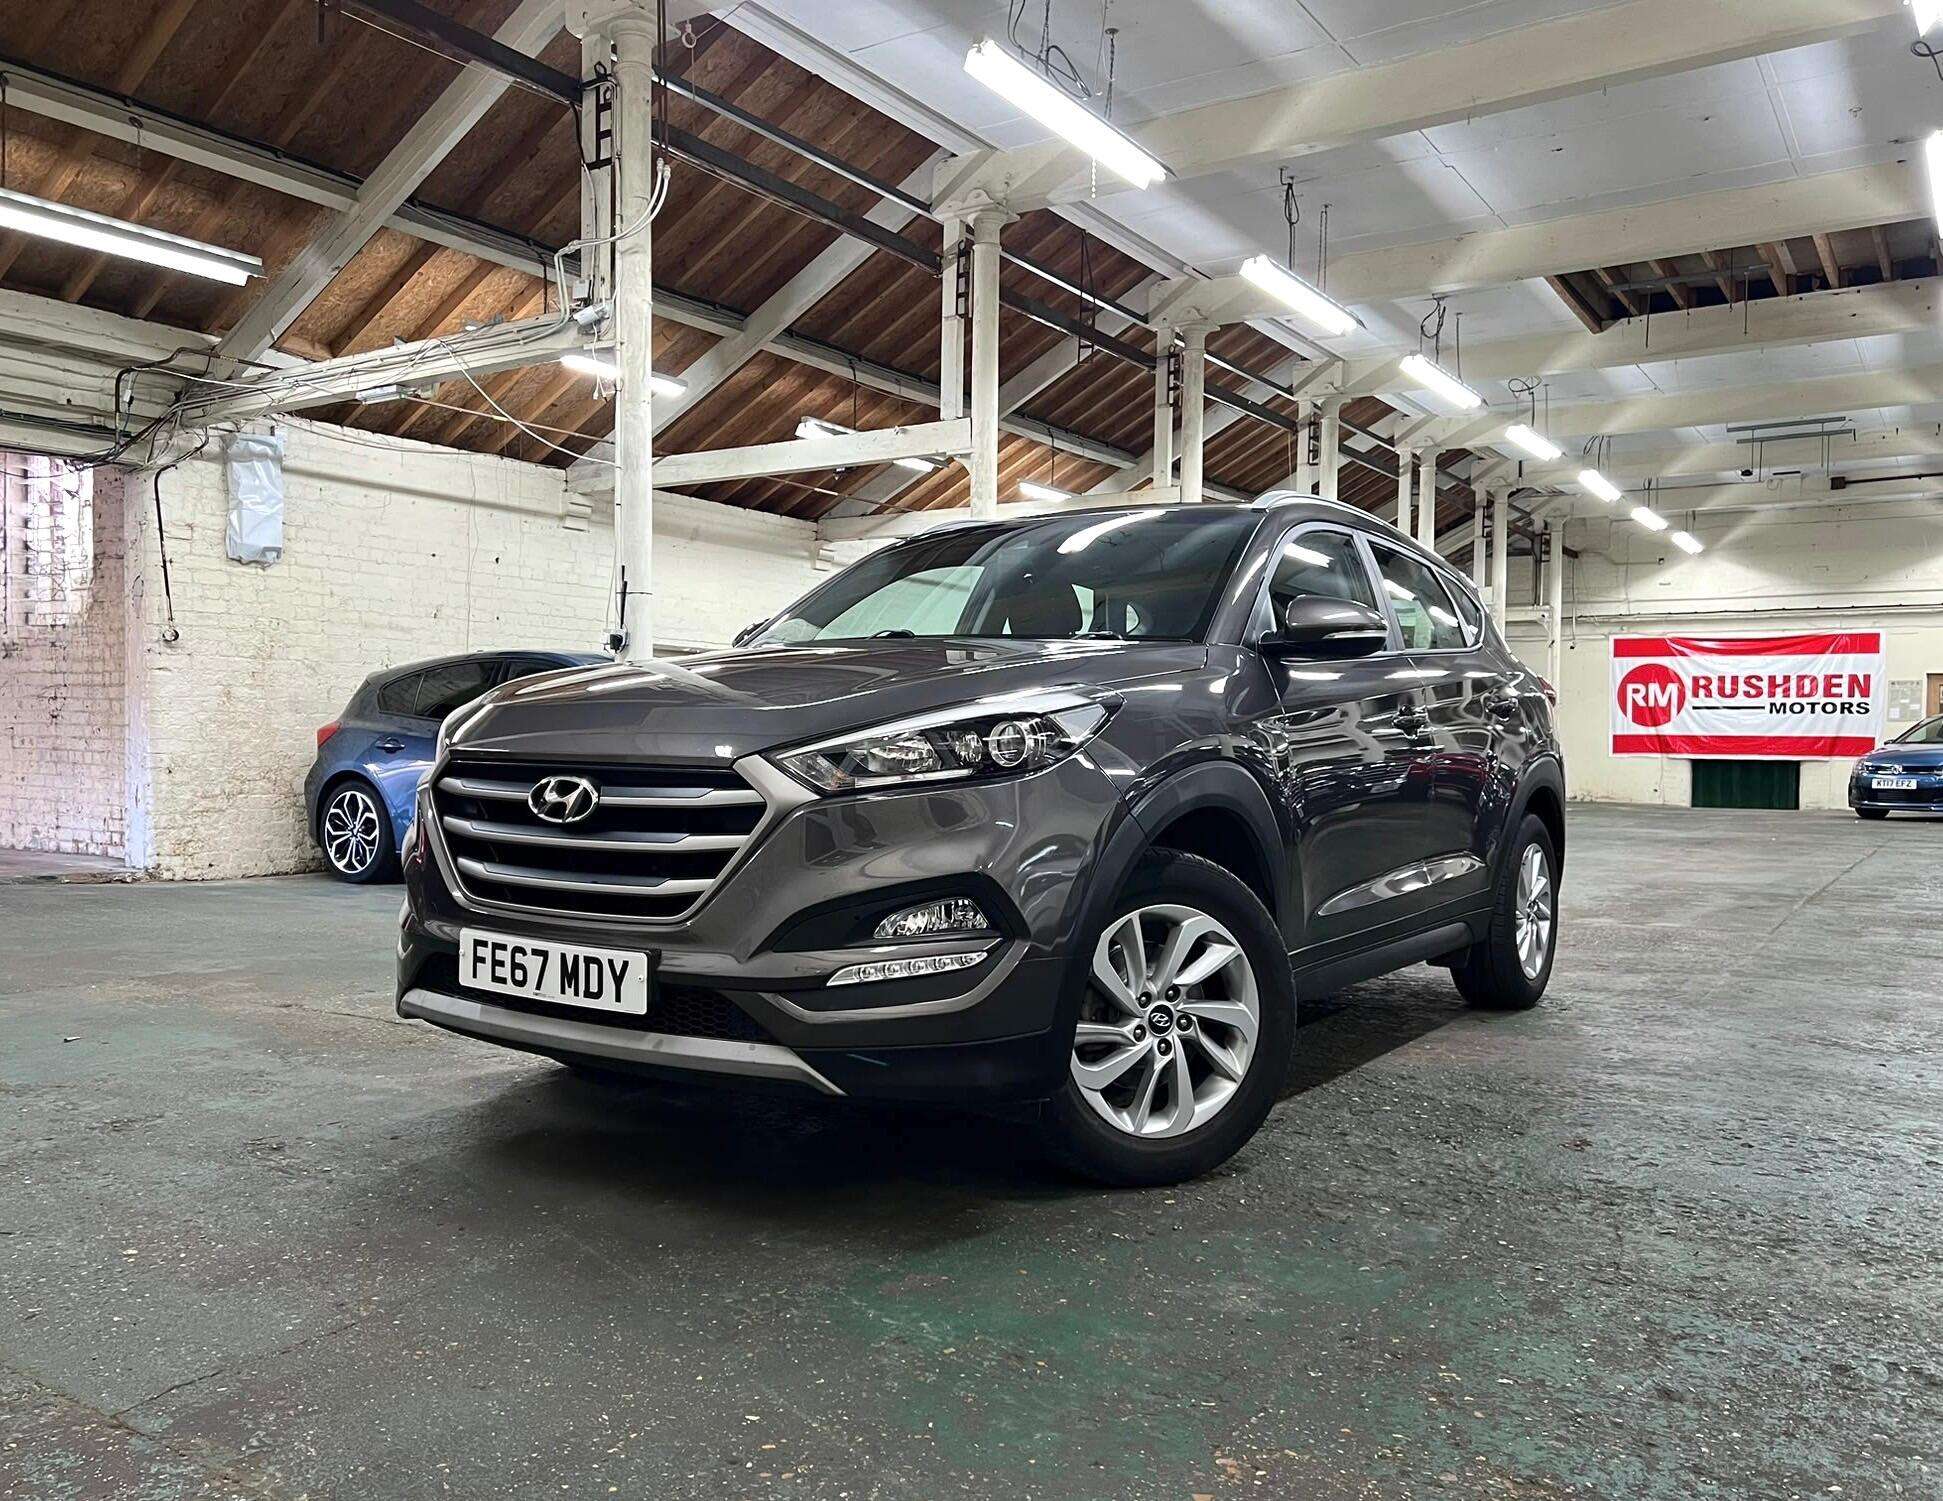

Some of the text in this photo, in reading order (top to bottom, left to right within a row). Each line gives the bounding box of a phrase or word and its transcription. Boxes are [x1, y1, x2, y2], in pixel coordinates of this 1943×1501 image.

[1624, 681, 1680, 721] RM
[1691, 673, 1871, 699] RUSHDEN
[1768, 701, 1871, 715] MOTORS
[472, 938, 630, 1004] FE67 MDY
